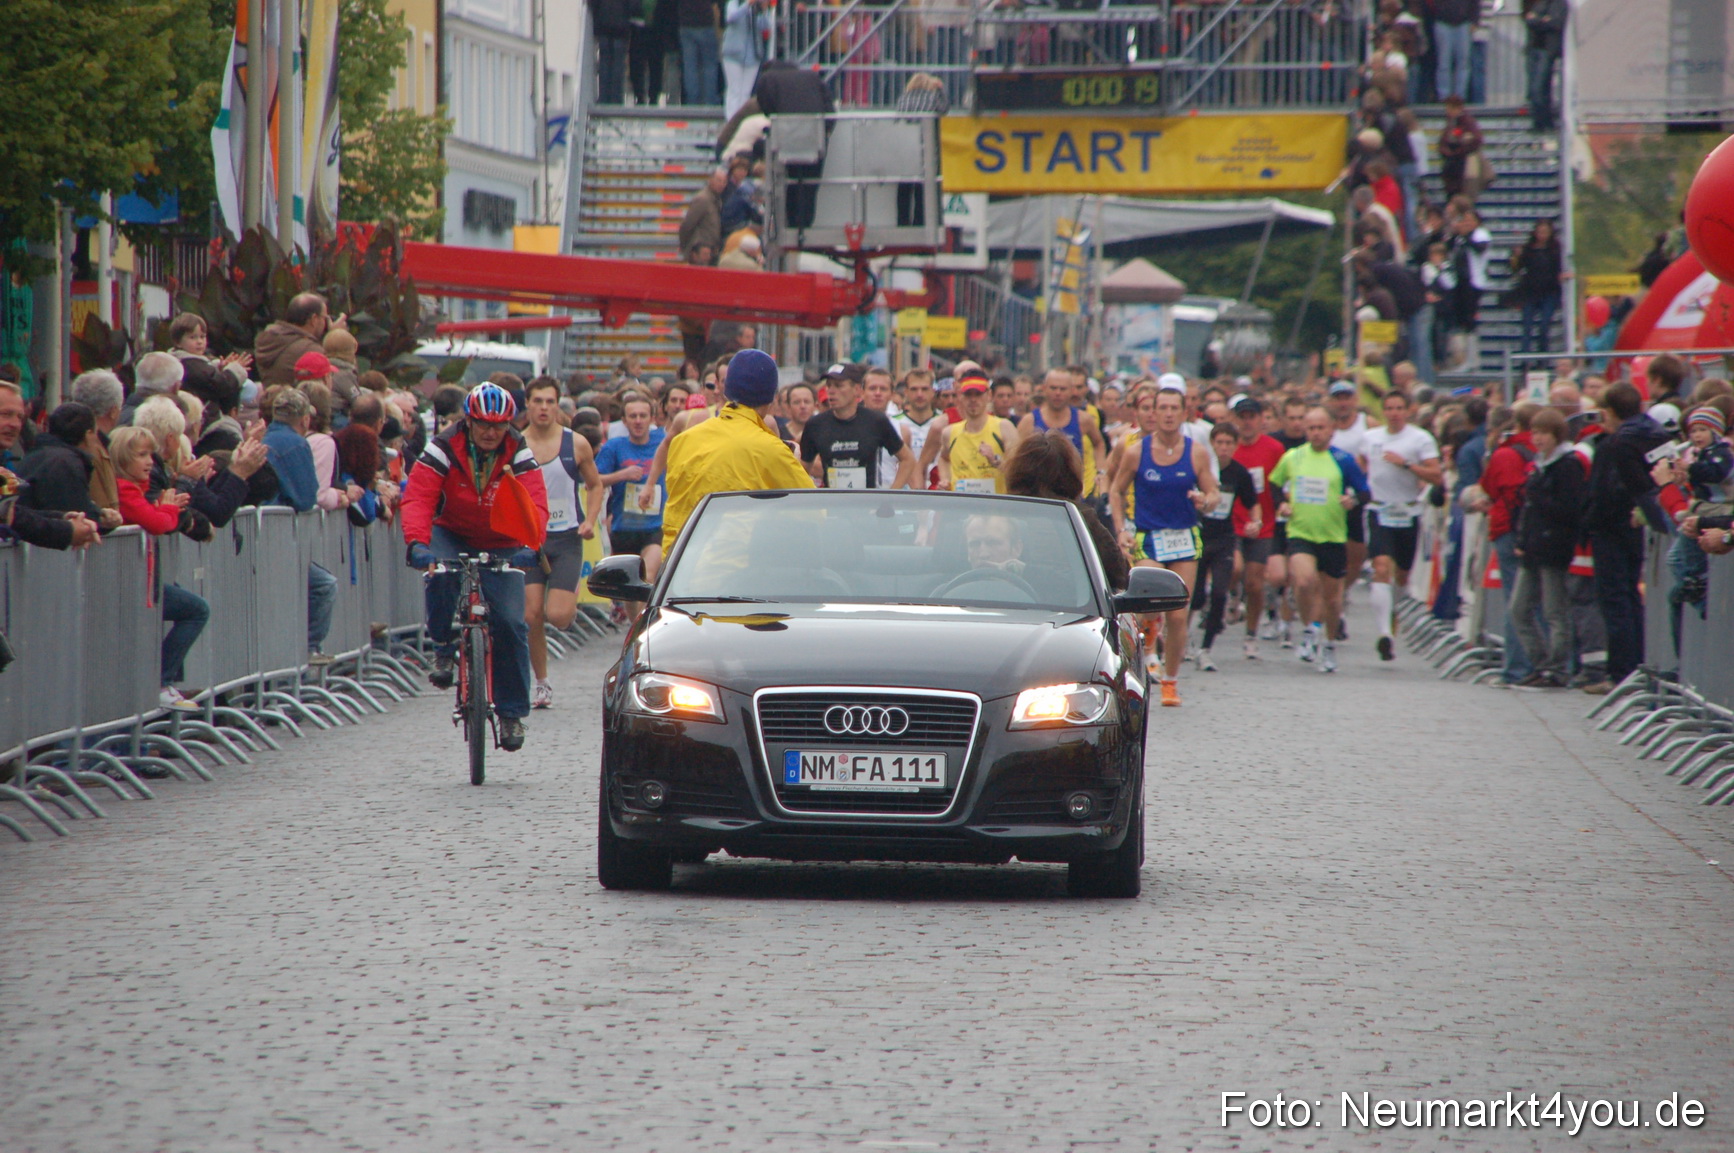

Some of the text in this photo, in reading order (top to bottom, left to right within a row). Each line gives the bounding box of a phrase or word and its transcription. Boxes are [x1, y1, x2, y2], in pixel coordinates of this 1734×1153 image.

[974, 129, 1162, 174] START
[549, 510, 564, 519] 02
[1167, 538, 1189, 549] 2612
[789, 769, 796, 778] D
[801, 755, 940, 783] NM FA 111
